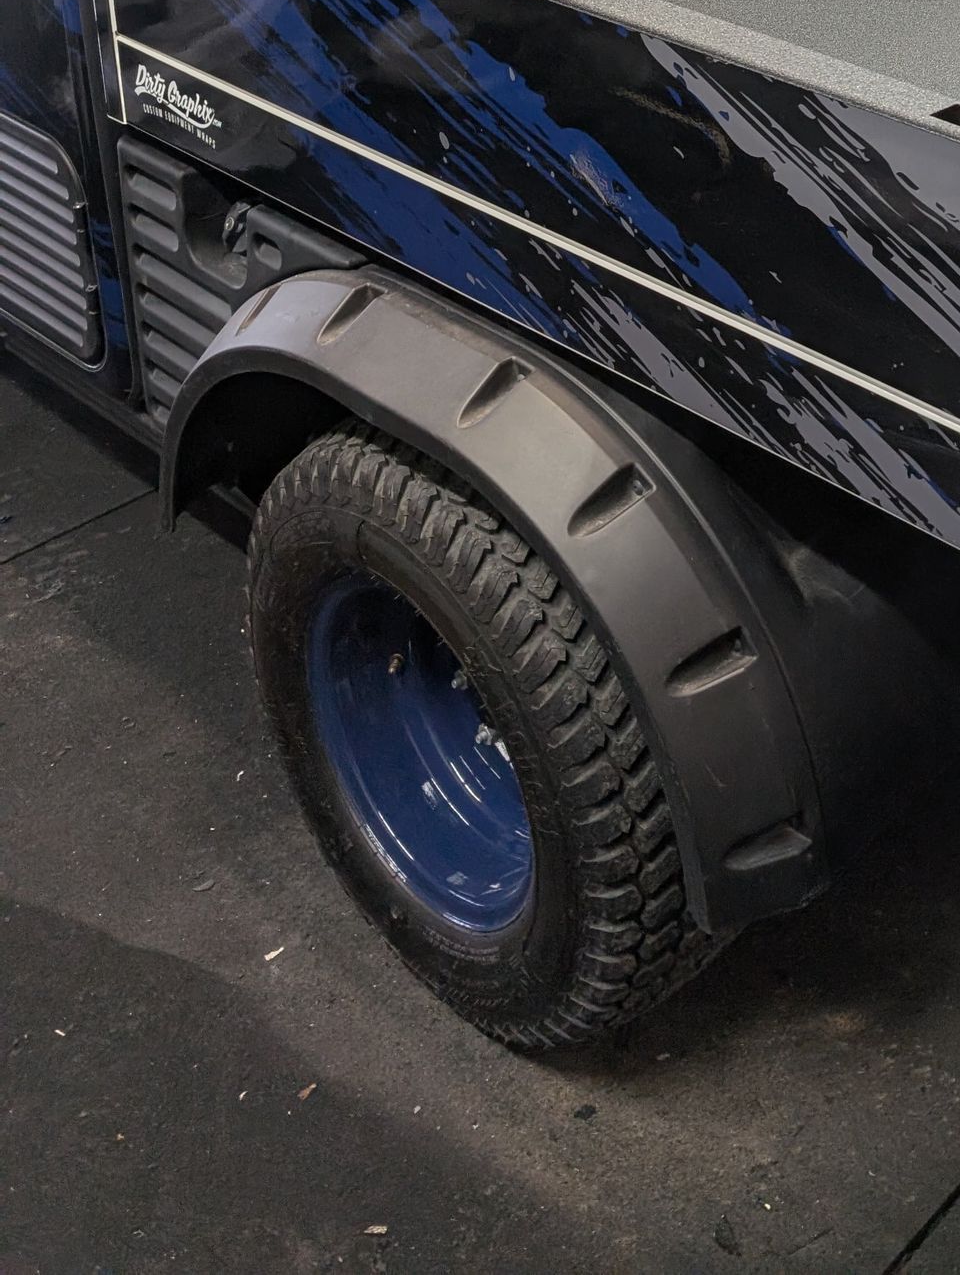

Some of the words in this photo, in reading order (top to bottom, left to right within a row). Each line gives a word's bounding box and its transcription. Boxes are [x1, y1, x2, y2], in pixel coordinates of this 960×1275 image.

[135, 64, 166, 104] Dirty
[167, 80, 215, 123] Graphix
[143, 103, 163, 118] CUSTOM
[165, 111, 194, 134] EQUIPMENT
[196, 128, 216, 149] WRAPS
